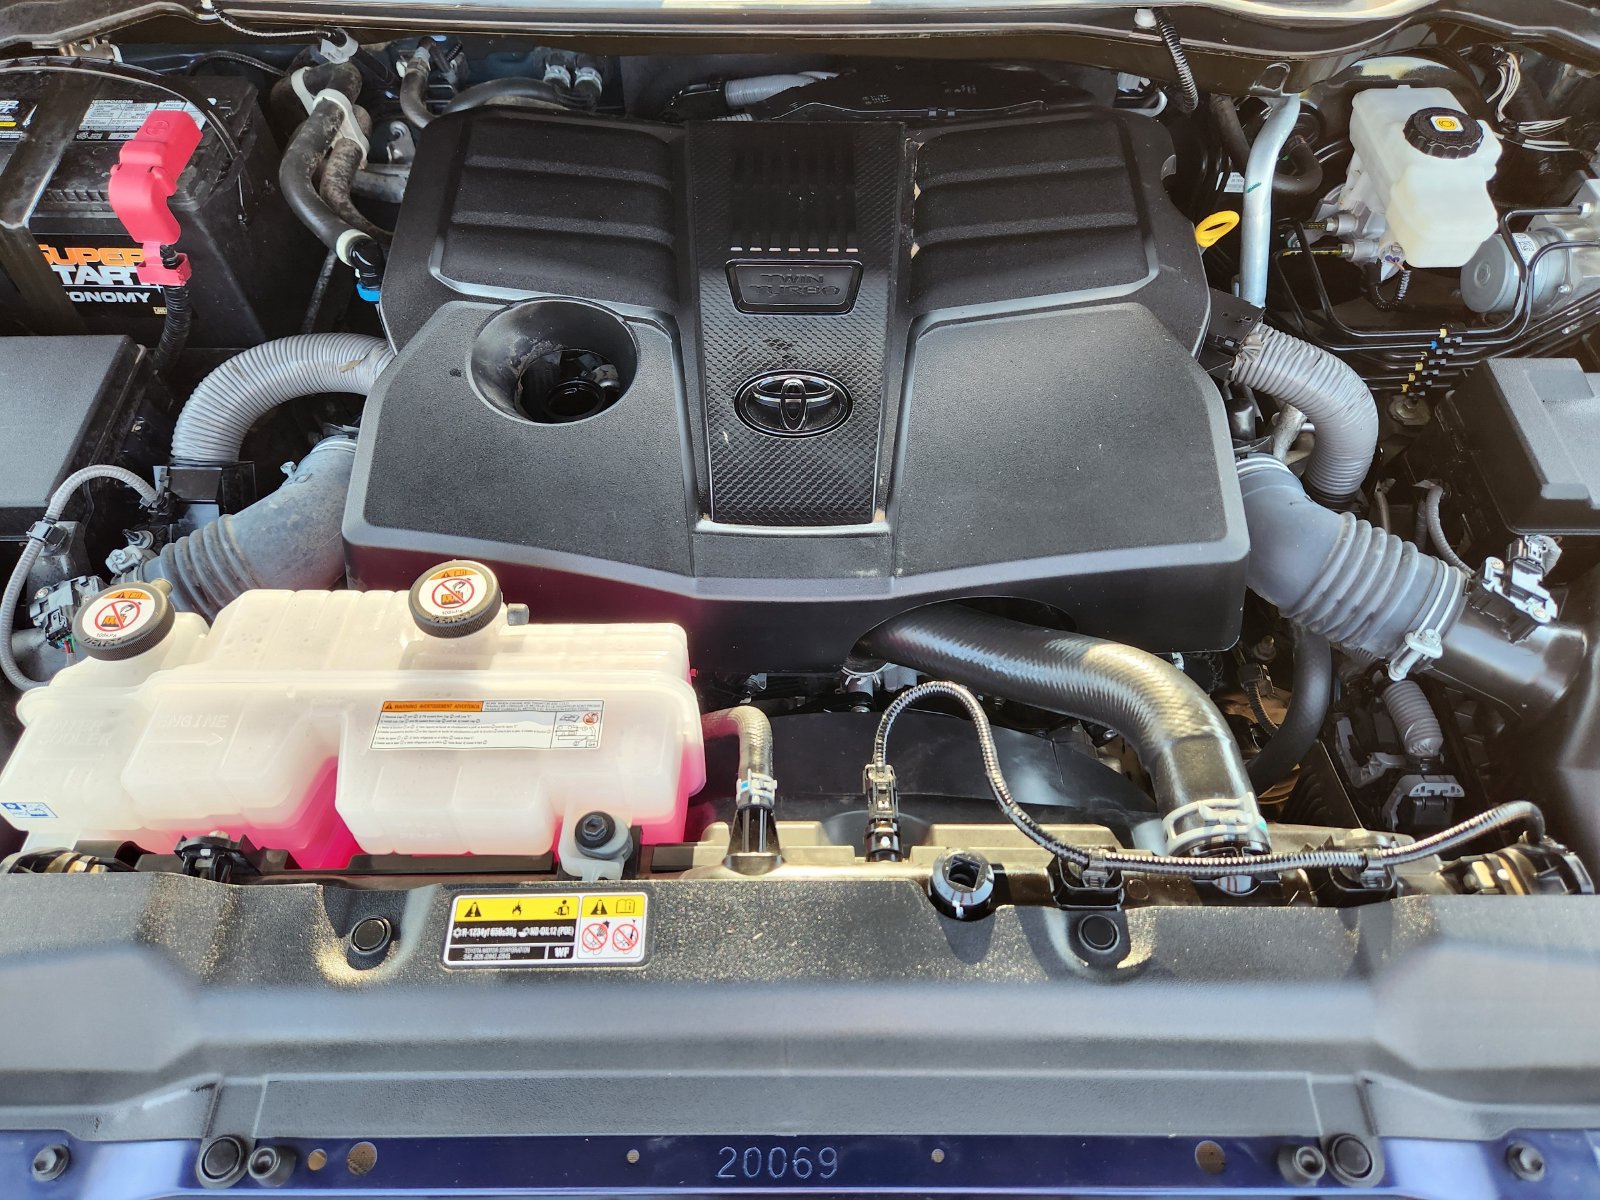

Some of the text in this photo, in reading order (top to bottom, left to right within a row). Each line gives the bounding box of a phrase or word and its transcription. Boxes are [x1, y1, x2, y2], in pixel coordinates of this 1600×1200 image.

[760, 273, 824, 284] TWIN
[749, 284, 840, 297] TURBO
[66, 291, 151, 303] ONOMY
[554, 946, 570, 958] WF
[715, 1146, 838, 1179] 20069
